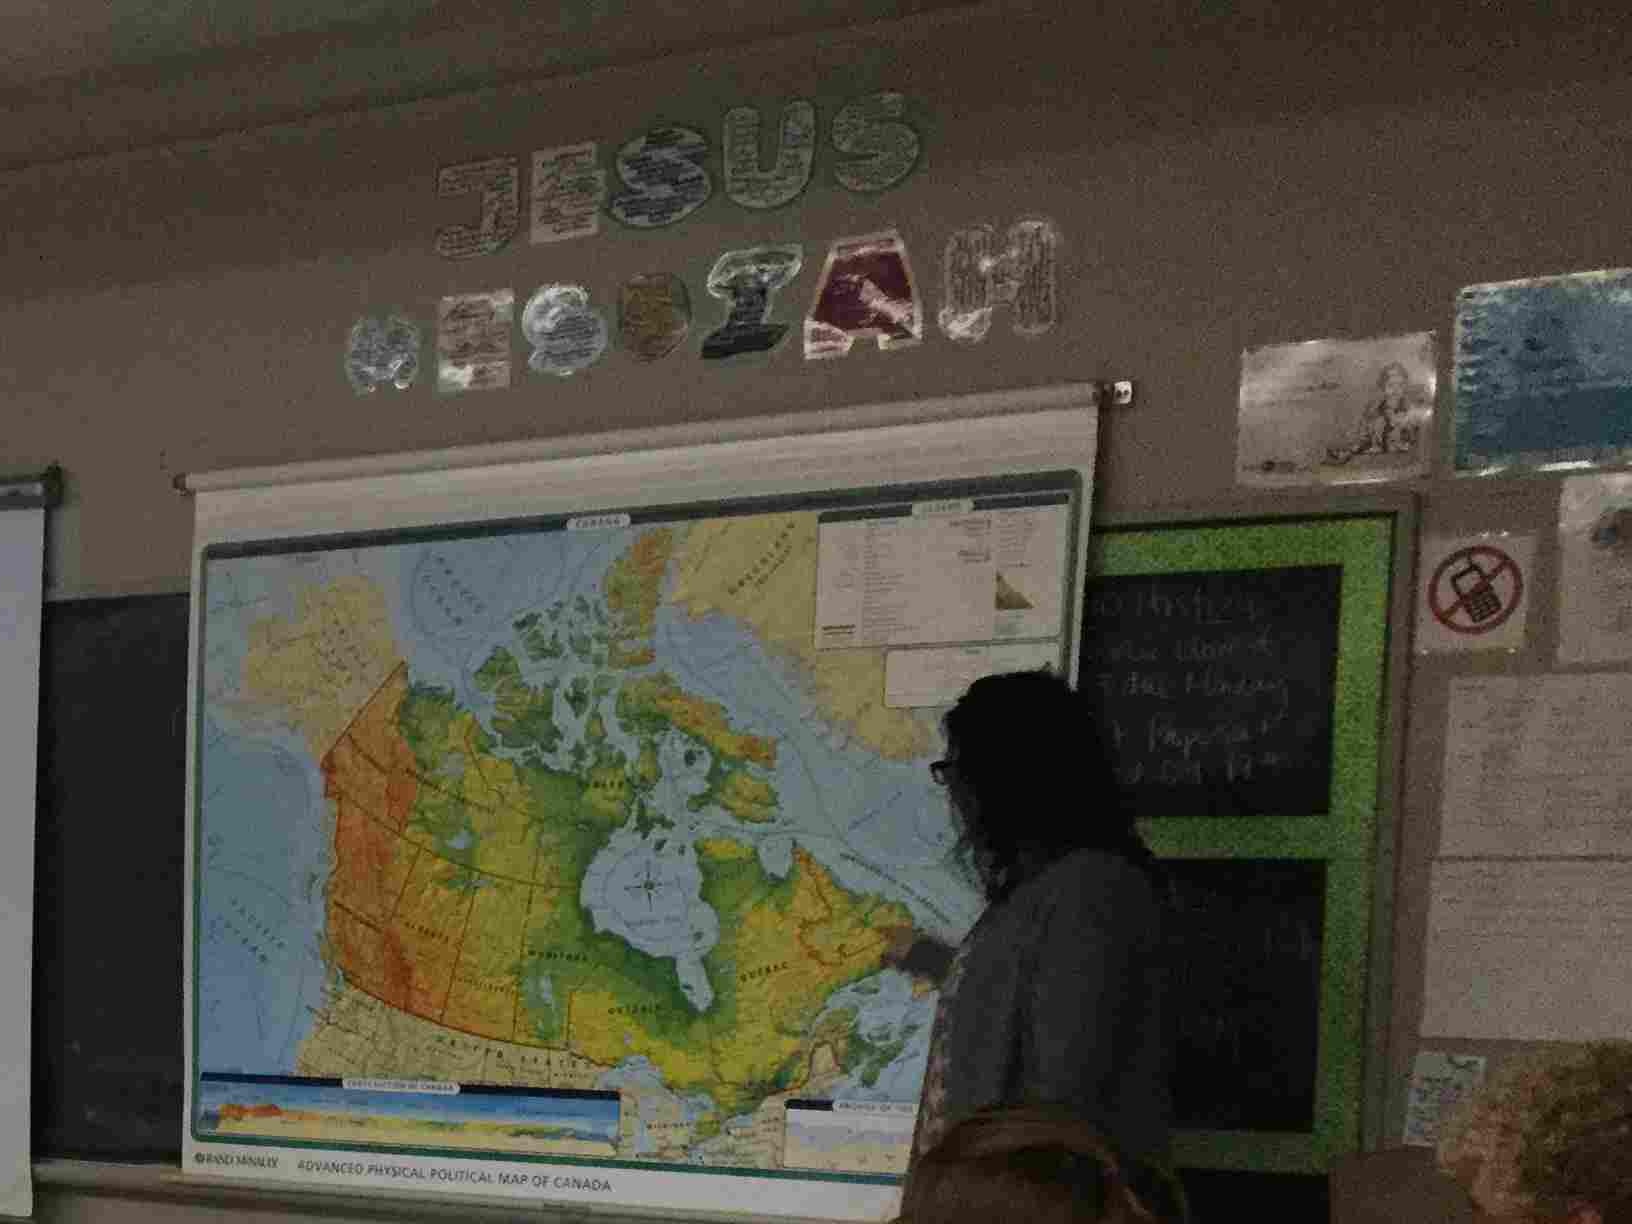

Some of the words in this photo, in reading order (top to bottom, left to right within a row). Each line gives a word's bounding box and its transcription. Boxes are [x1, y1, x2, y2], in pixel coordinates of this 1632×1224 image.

[434, 90, 923, 259] JESUS
[297, 1158, 364, 1176] ADVANCED
[366, 1163, 426, 1179] PHYSICAL
[430, 1167, 494, 1185] POLITICAL
[498, 1172, 528, 1186] MAP
[532, 1174, 552, 1188] OF
[553, 1175, 613, 1192] CANADA
